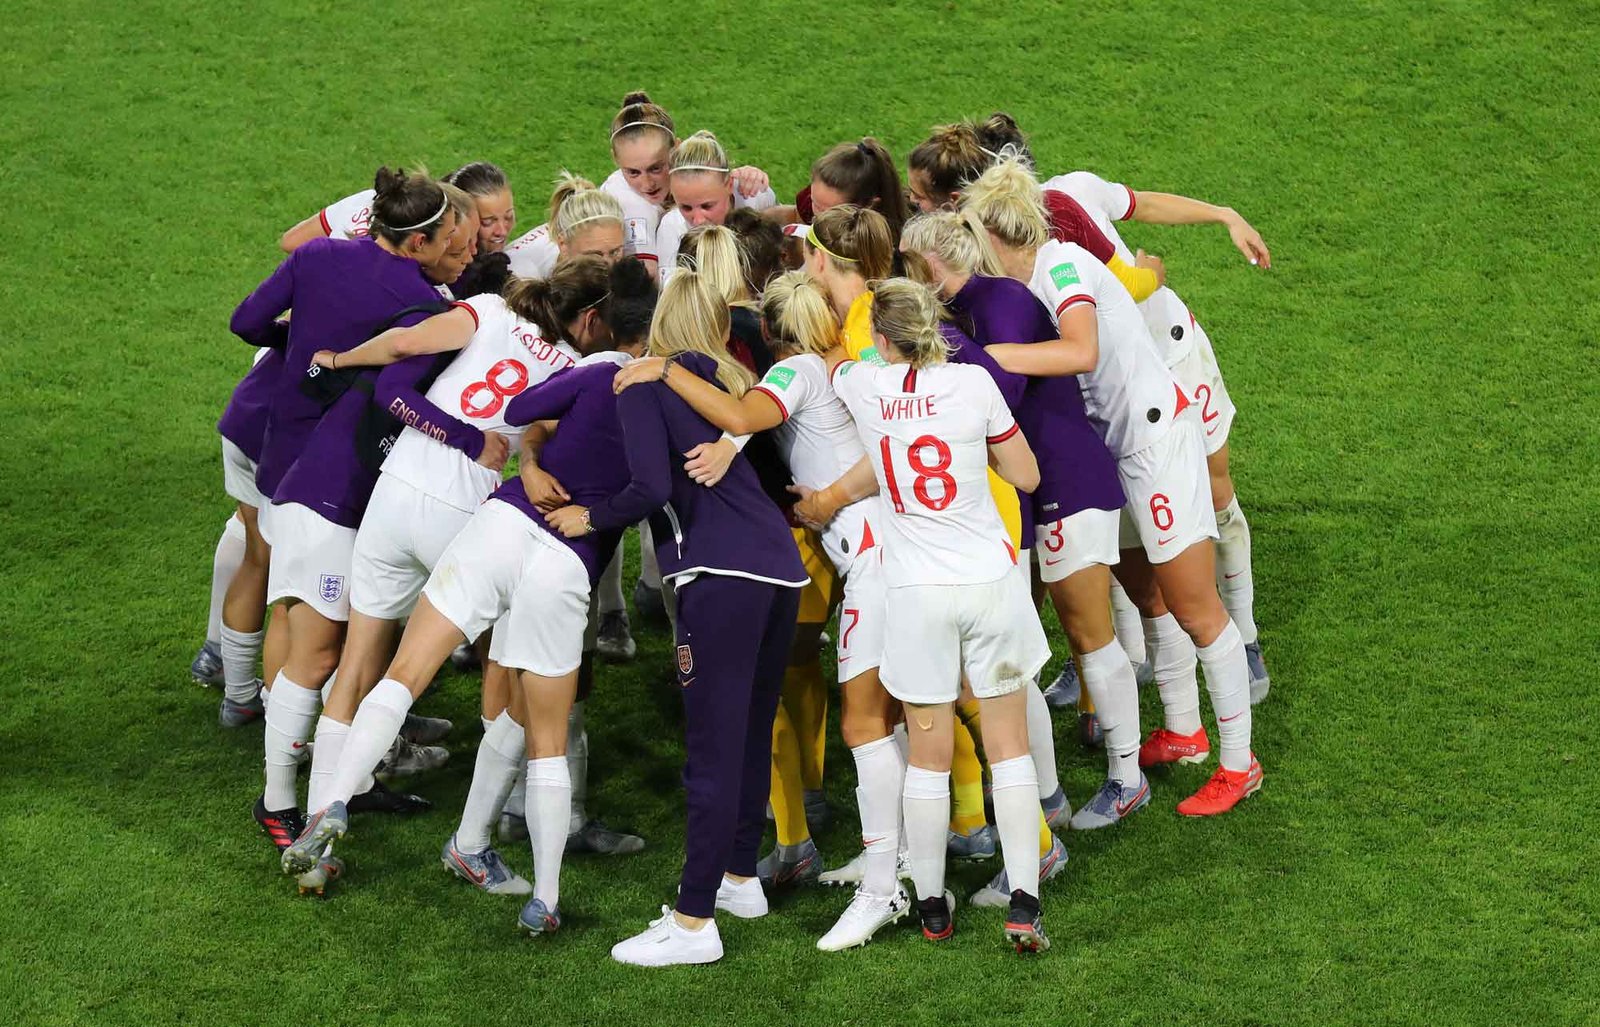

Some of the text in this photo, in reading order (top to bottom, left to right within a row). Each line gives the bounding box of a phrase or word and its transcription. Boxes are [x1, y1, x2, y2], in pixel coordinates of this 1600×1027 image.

[460, 358, 529, 419] 8
[880, 395, 937, 420] WHITE
[1194, 384, 1219, 423] 2
[388, 397, 447, 444] ENGLAND
[879, 434, 958, 514] 18
[1149, 492, 1174, 532] 6
[1044, 519, 1065, 553] 3
